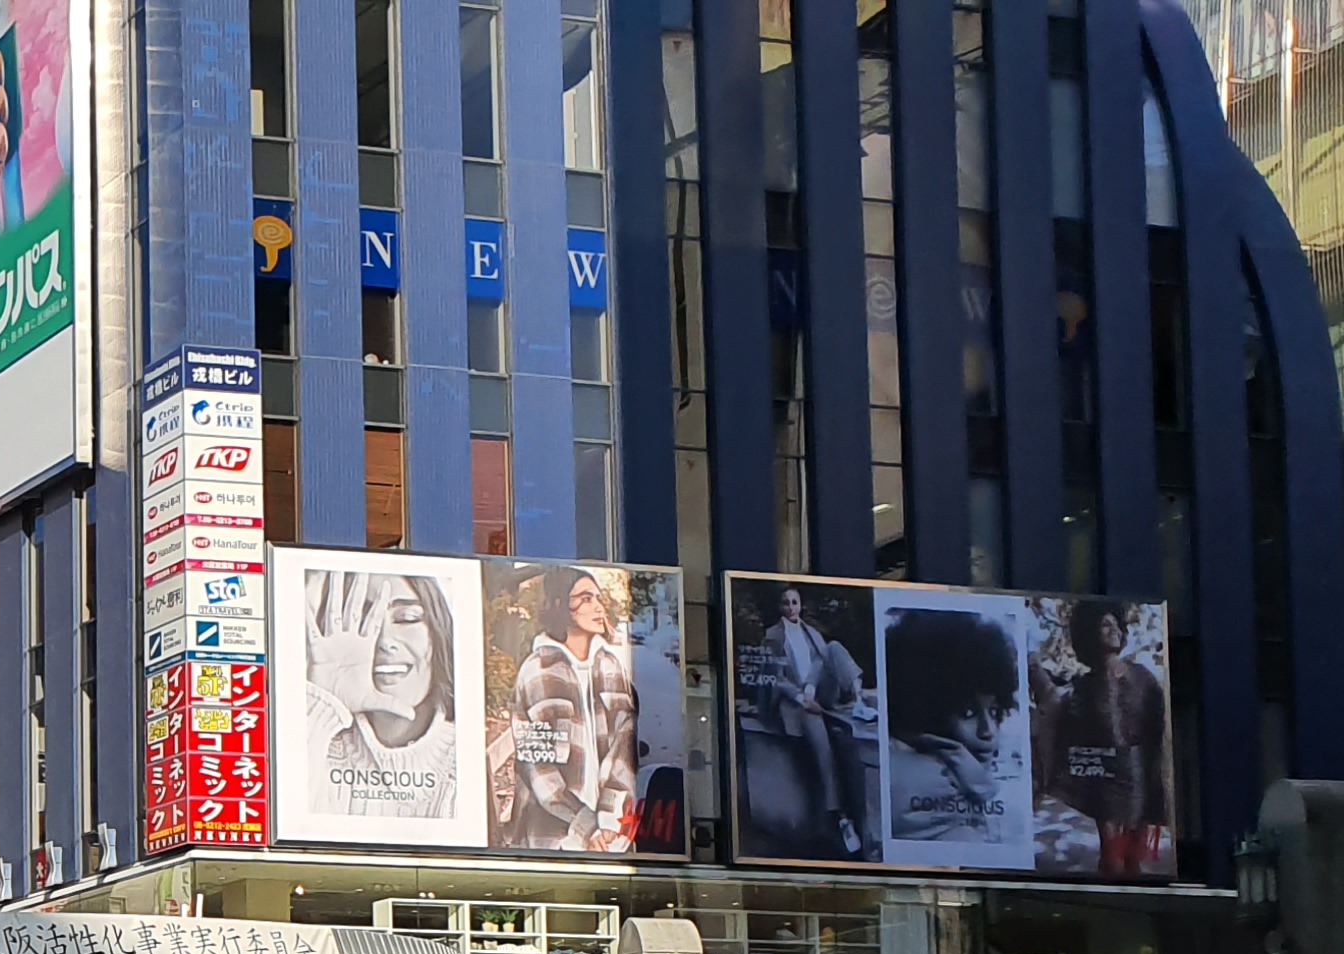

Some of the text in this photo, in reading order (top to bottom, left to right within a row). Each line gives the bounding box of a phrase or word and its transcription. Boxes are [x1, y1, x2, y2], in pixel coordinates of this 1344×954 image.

[215, 401, 254, 412] Ctrip
[151, 452, 176, 481] TKP
[199, 446, 248, 469] TKP
[213, 538, 258, 549] HanaTour
[168, 665, 185, 826] インターネット
[232, 665, 263, 823] インターネット
[516, 750, 556, 764] ¥3,999
[150, 743, 166, 832] コミック
[197, 733, 227, 823] コミック
[330, 768, 435, 789] CONSCIOUS
[351, 788, 416, 801] COLLECTION
